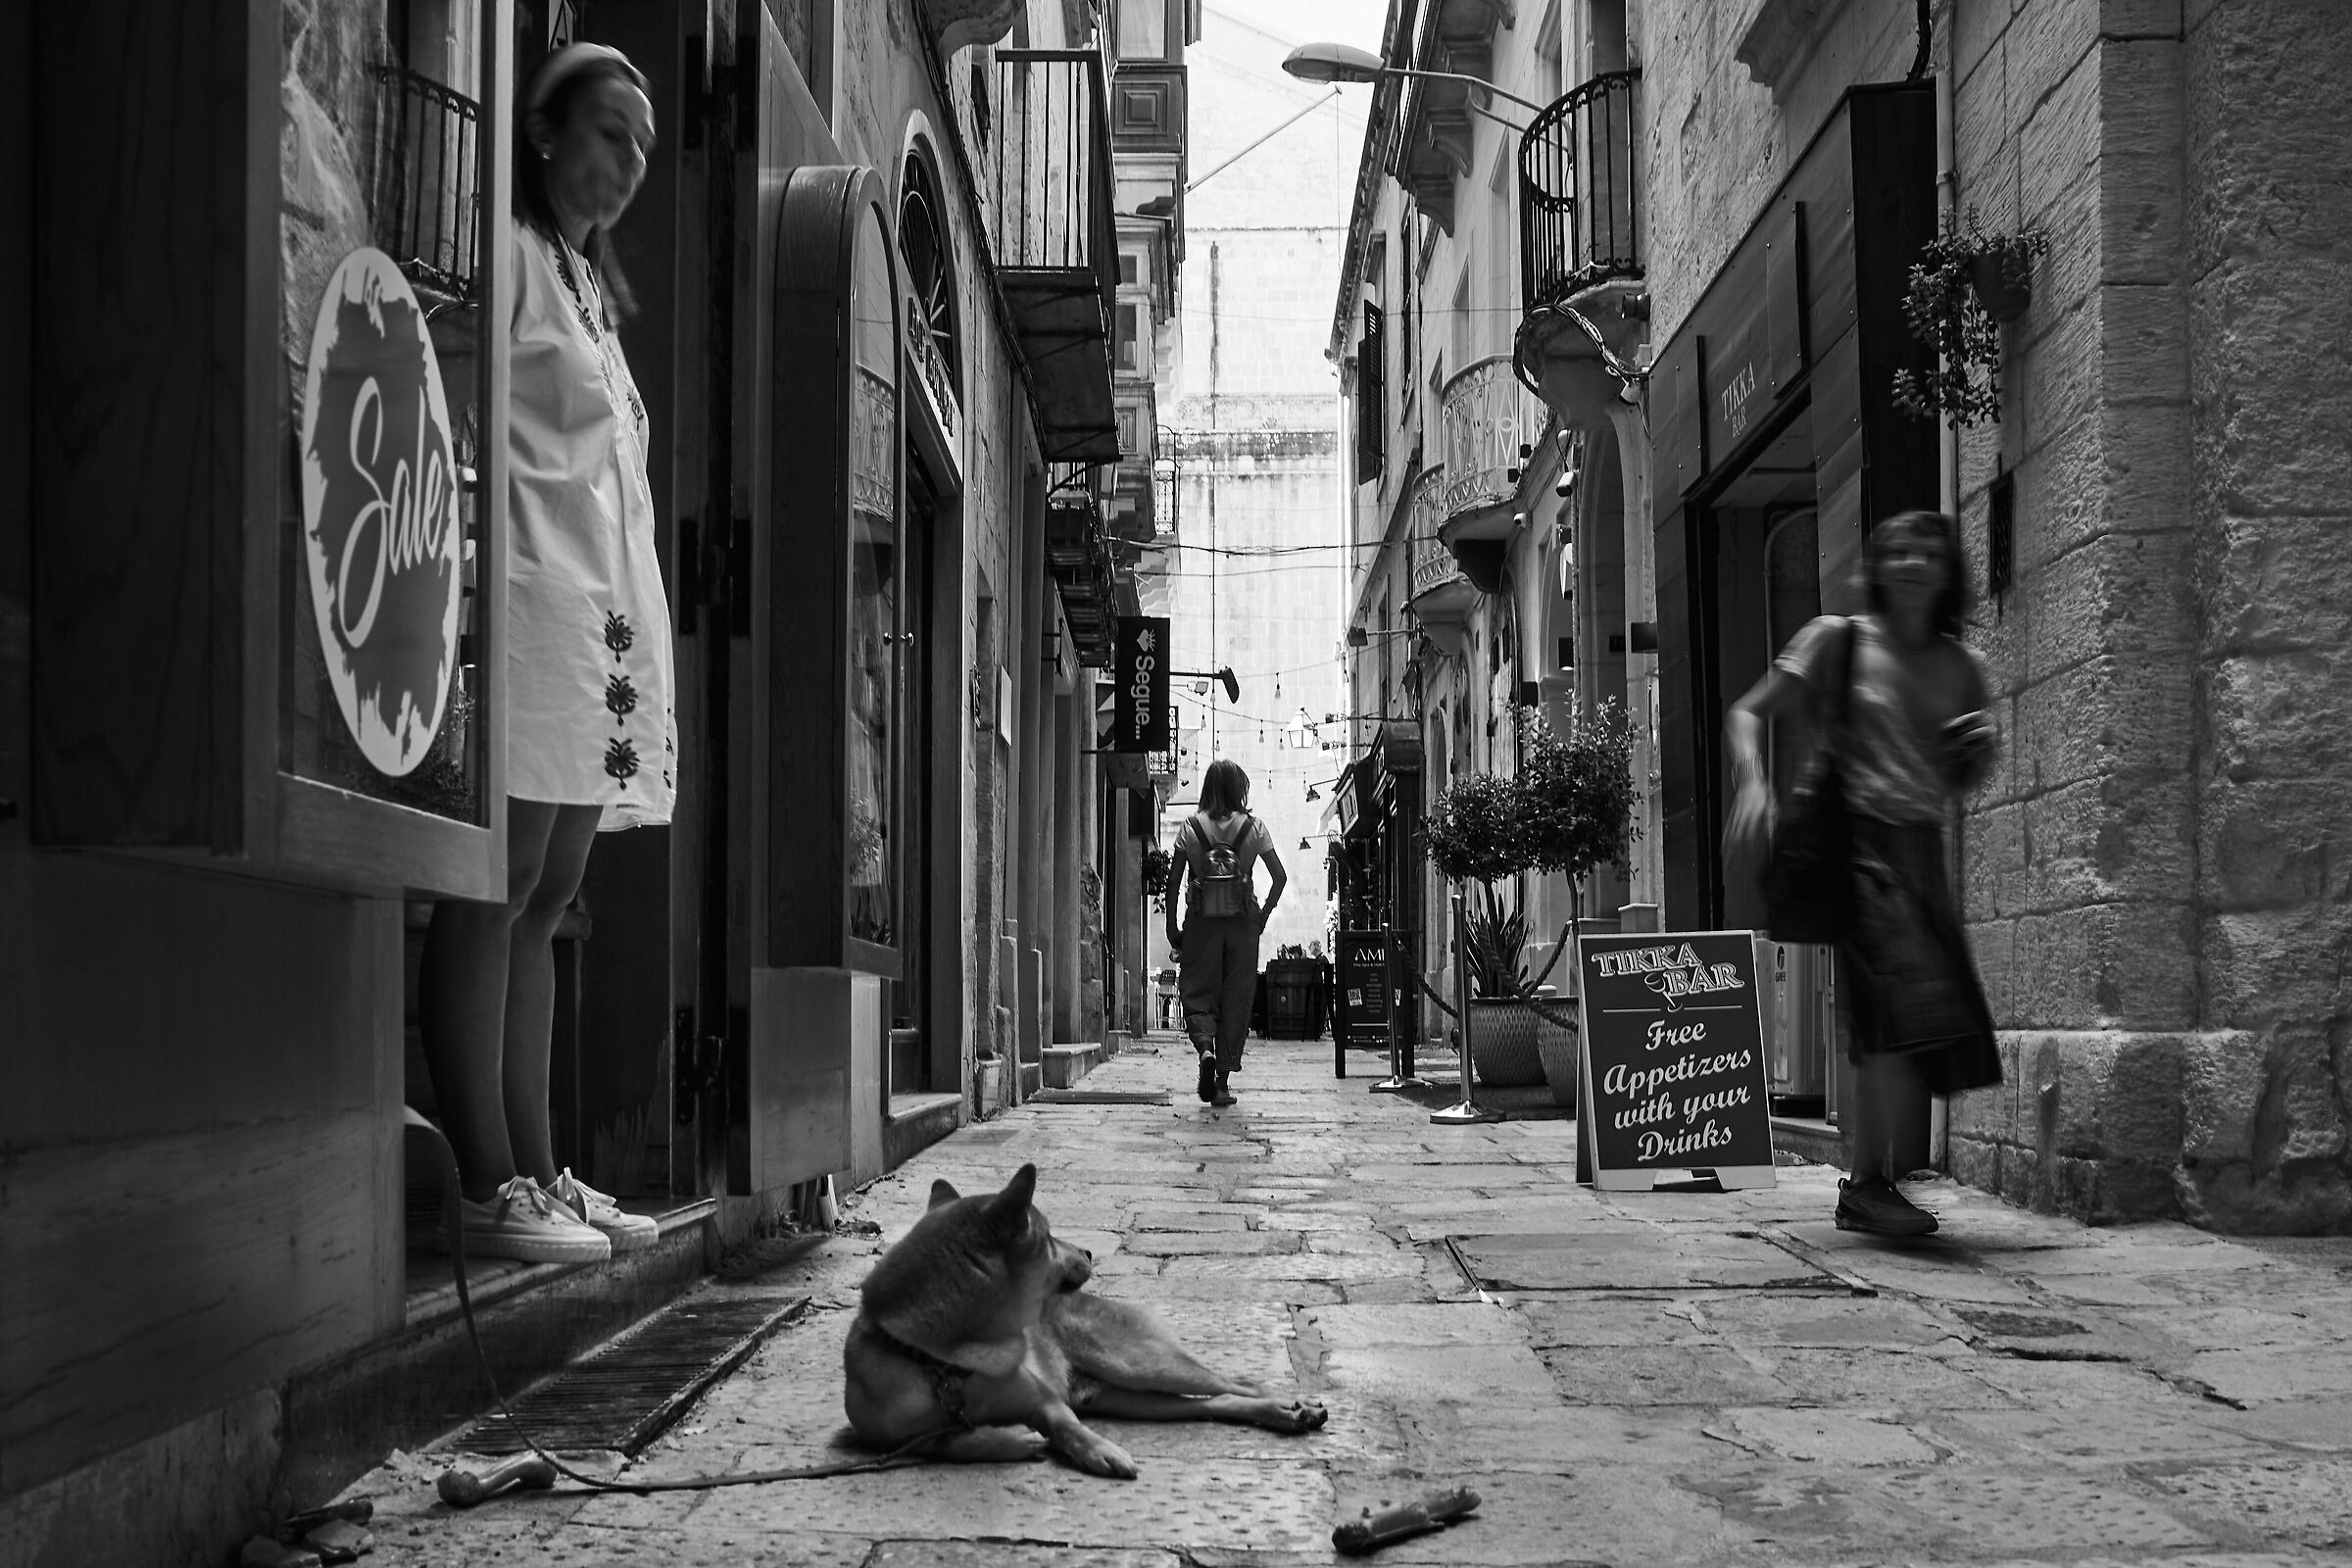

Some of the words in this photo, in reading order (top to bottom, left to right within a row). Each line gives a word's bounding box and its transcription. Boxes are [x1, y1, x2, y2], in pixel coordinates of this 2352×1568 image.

[1721, 360, 1755, 422] TIKKA
[1732, 406, 1746, 438] BAR
[337, 375, 446, 649] Sale
[1591, 942, 1703, 978] TIKKA
[1663, 961, 1745, 998] BAR
[1644, 1019, 1707, 1052] Free
[1603, 1049, 1752, 1100] Appetizers
[1614, 1091, 1676, 1130] with
[1683, 1085, 1751, 1125] your
[1638, 1118, 1734, 1162] Drinks
